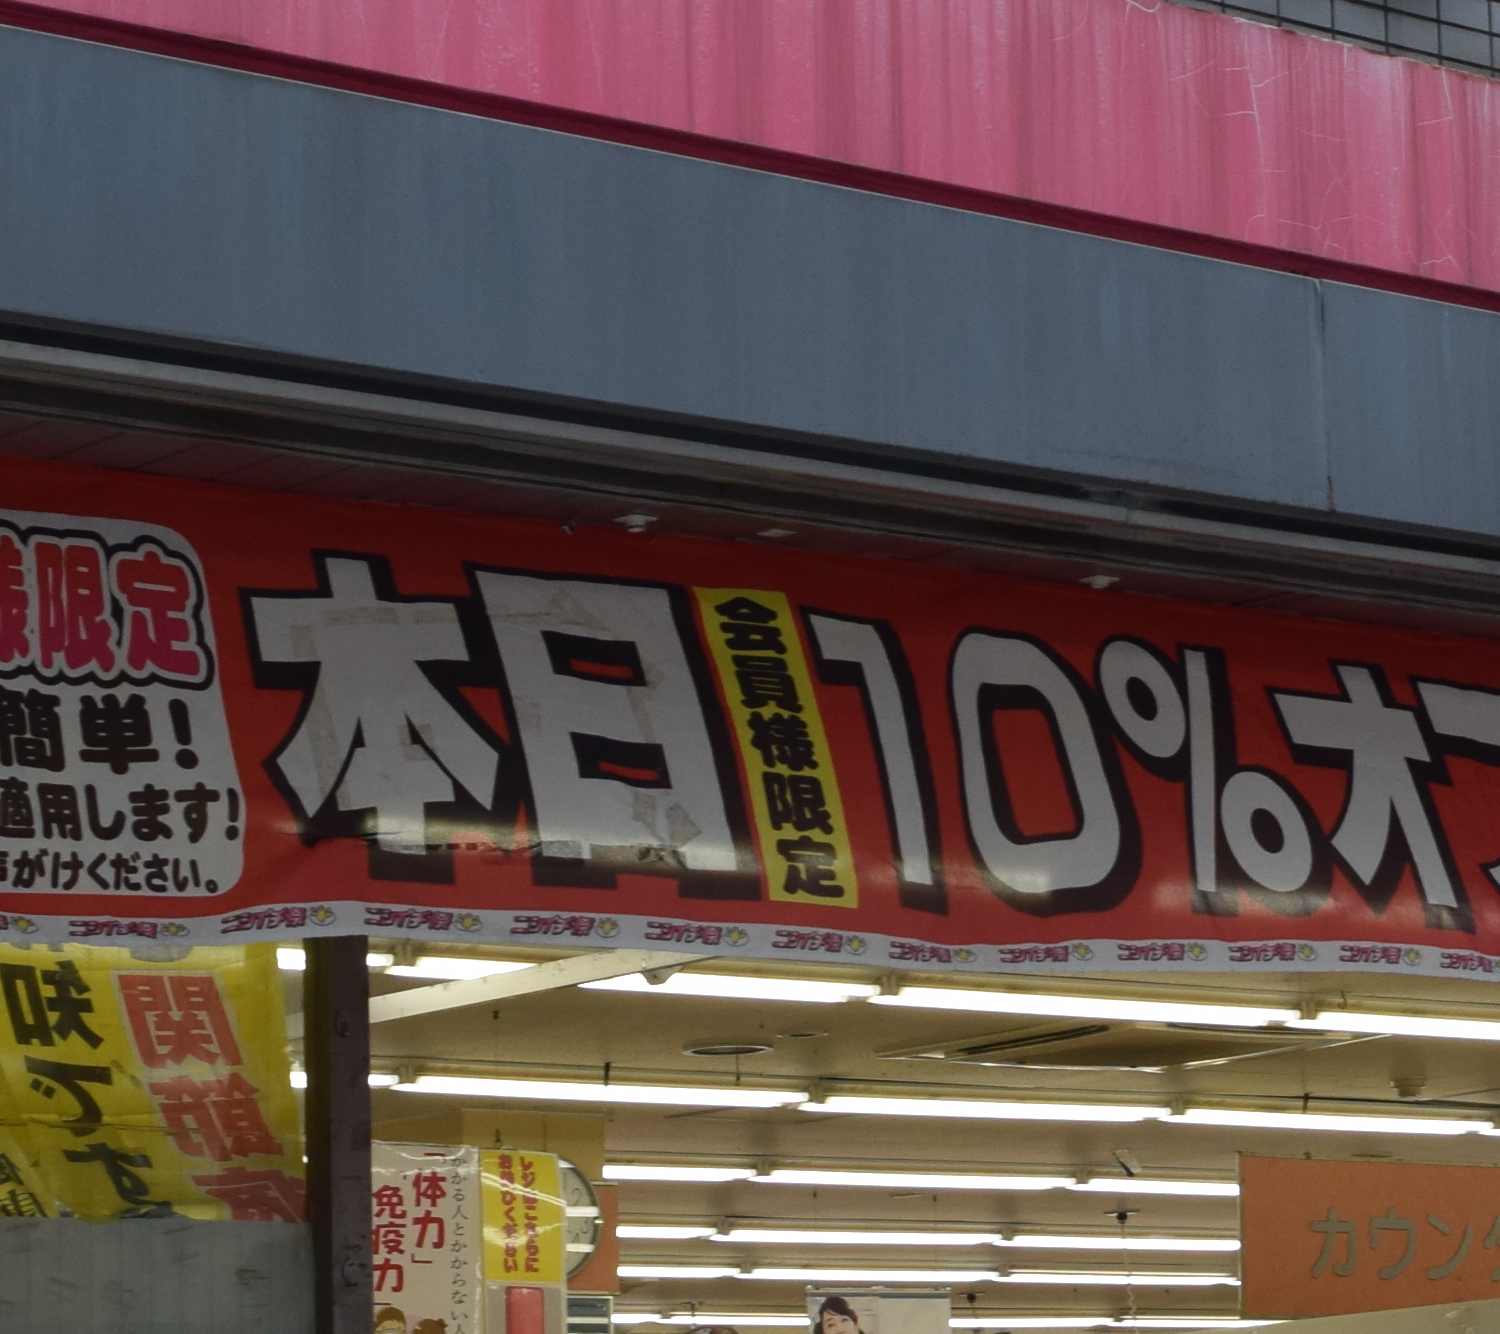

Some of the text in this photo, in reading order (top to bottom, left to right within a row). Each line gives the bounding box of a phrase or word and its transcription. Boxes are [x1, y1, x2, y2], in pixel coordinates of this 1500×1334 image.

[244, 554, 740, 878] 本日
[712, 596, 846, 901] 会員様限定
